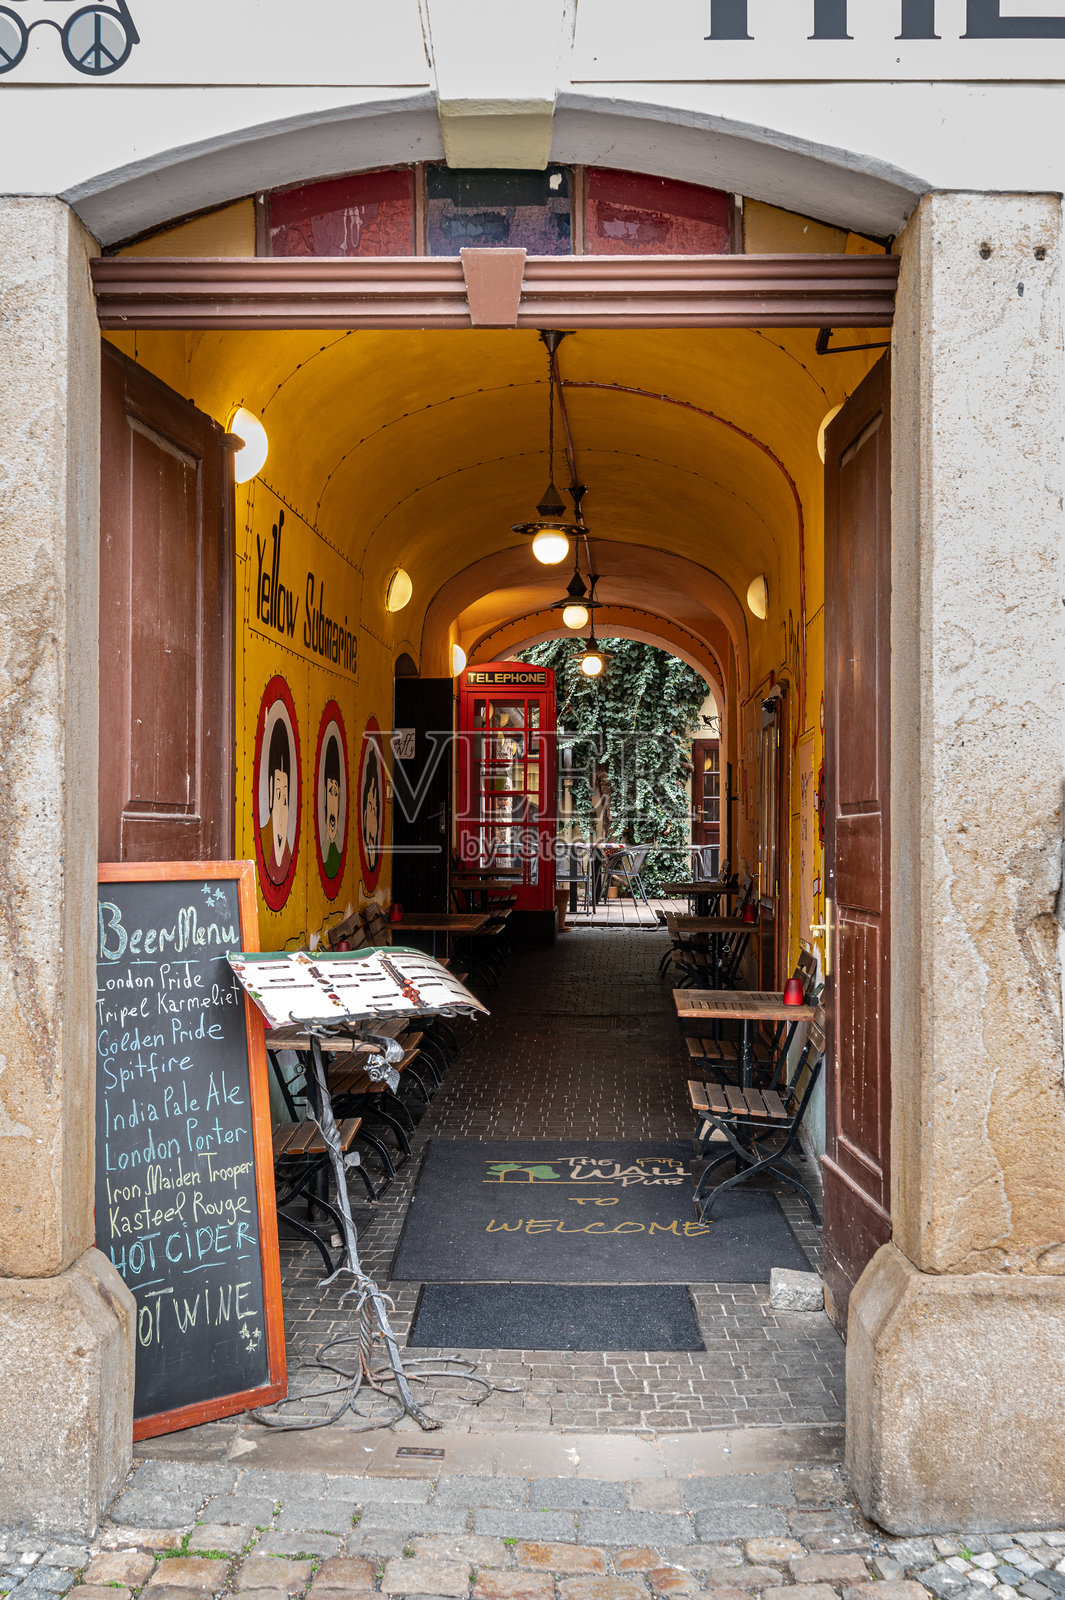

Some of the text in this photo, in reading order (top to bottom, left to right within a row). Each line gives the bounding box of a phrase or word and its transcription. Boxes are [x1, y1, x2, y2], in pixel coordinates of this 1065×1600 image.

[256, 509, 358, 674] Yellow Submarine
[468, 673, 546, 683] TELEPHONE
[160, 963, 205, 991] Pride
[96, 976, 240, 1028] Tripel Karmeliet
[97, 1012, 224, 1057] Golden Pride
[103, 1052, 194, 1093] Spitfire
[104, 1070, 244, 1138] India Pale Ale
[105, 1117, 248, 1170] London Porter
[105, 1152, 254, 1205] Iron Maiden Trooper
[568, 1197, 620, 1206] TO
[109, 1190, 252, 1239] Kasteel Rouge
[485, 1218, 713, 1237] WELCOME
[110, 1231, 161, 1278] HOT
[138, 1287, 174, 1347] OT
